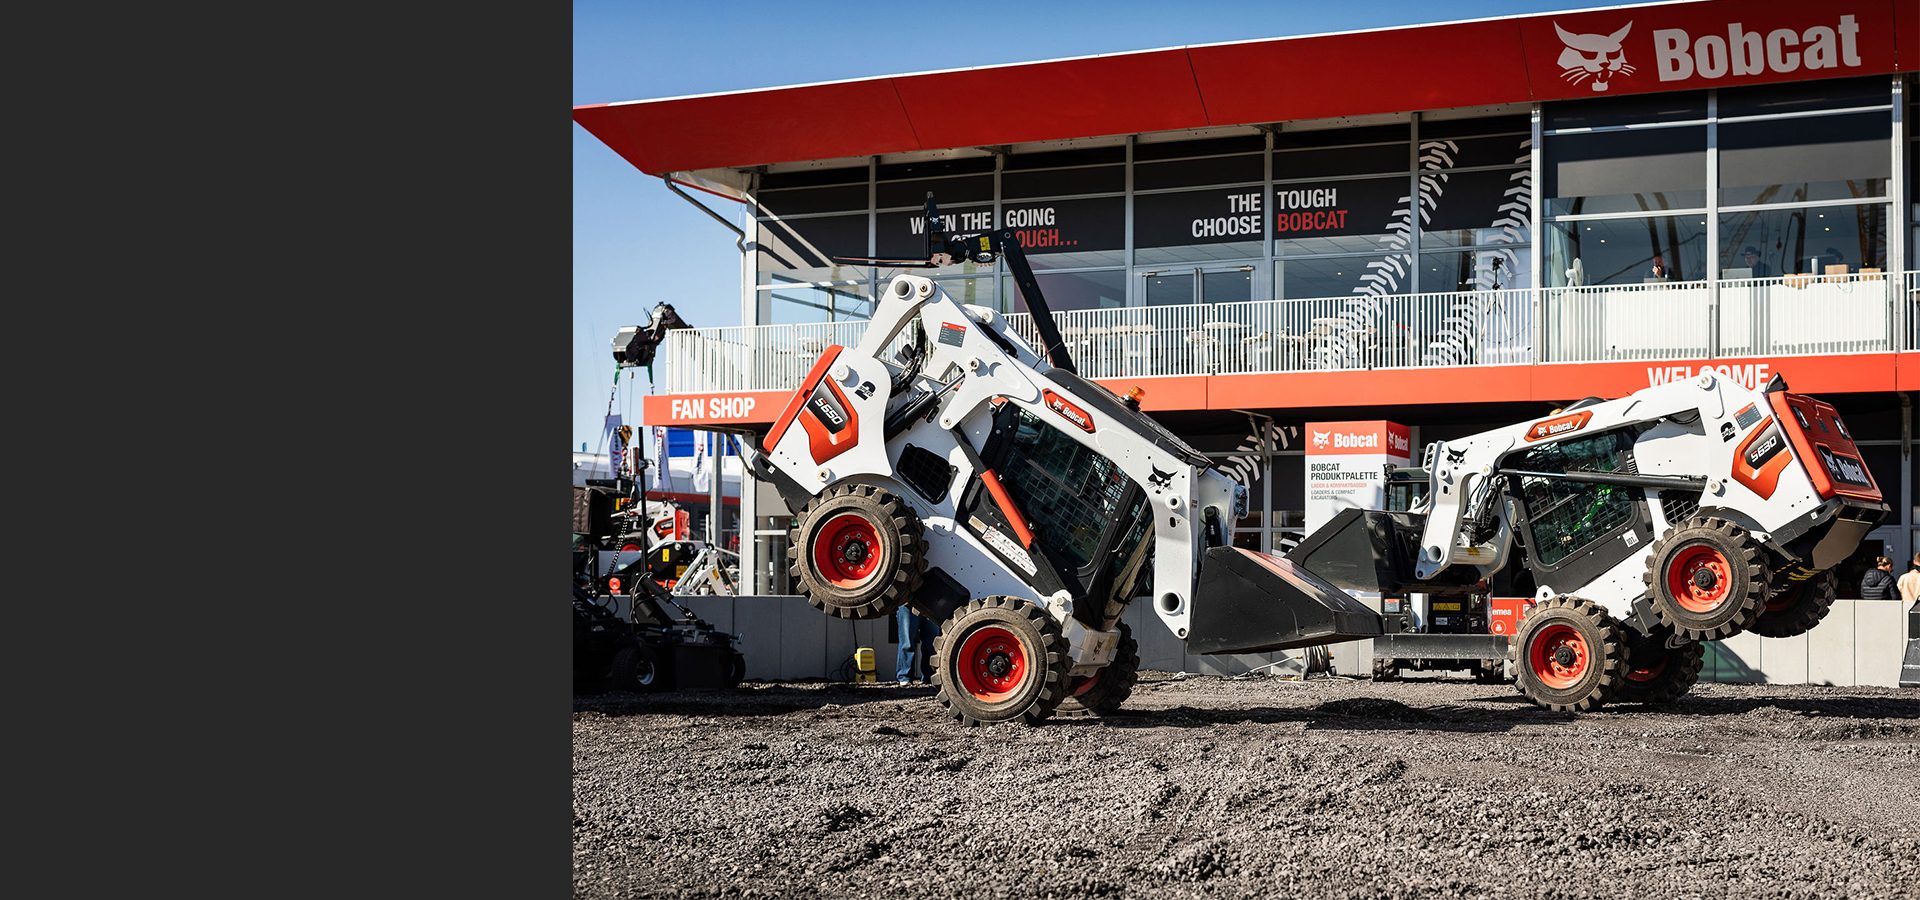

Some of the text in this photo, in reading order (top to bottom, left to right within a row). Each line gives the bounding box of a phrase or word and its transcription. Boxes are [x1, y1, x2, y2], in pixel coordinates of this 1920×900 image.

[1653, 14, 1862, 82] Bobcat
[1228, 188, 1337, 213] THE TOUGH
[910, 207, 1055, 235] WEN THE GOING
[1192, 210, 1348, 238] CHOOSE BOBCAT
[1015, 229, 1078, 249] OUGH...
[1647, 364, 1769, 389] WELOME
[671, 397, 755, 419] FAN SHOP
[815, 398, 844, 425] S650
[1062, 406, 1086, 427] Bobcat
[1549, 420, 1574, 434] Bobcat
[1334, 432, 1378, 448] Bobcat
[1394, 434, 1409, 452] Bobcat
[1751, 435, 1778, 463] S630
[1311, 463, 1340, 471] BOBCAT
[1311, 472, 1378, 480] PRODUKTPALETTE
[1836, 458, 1872, 488] Bobcat
